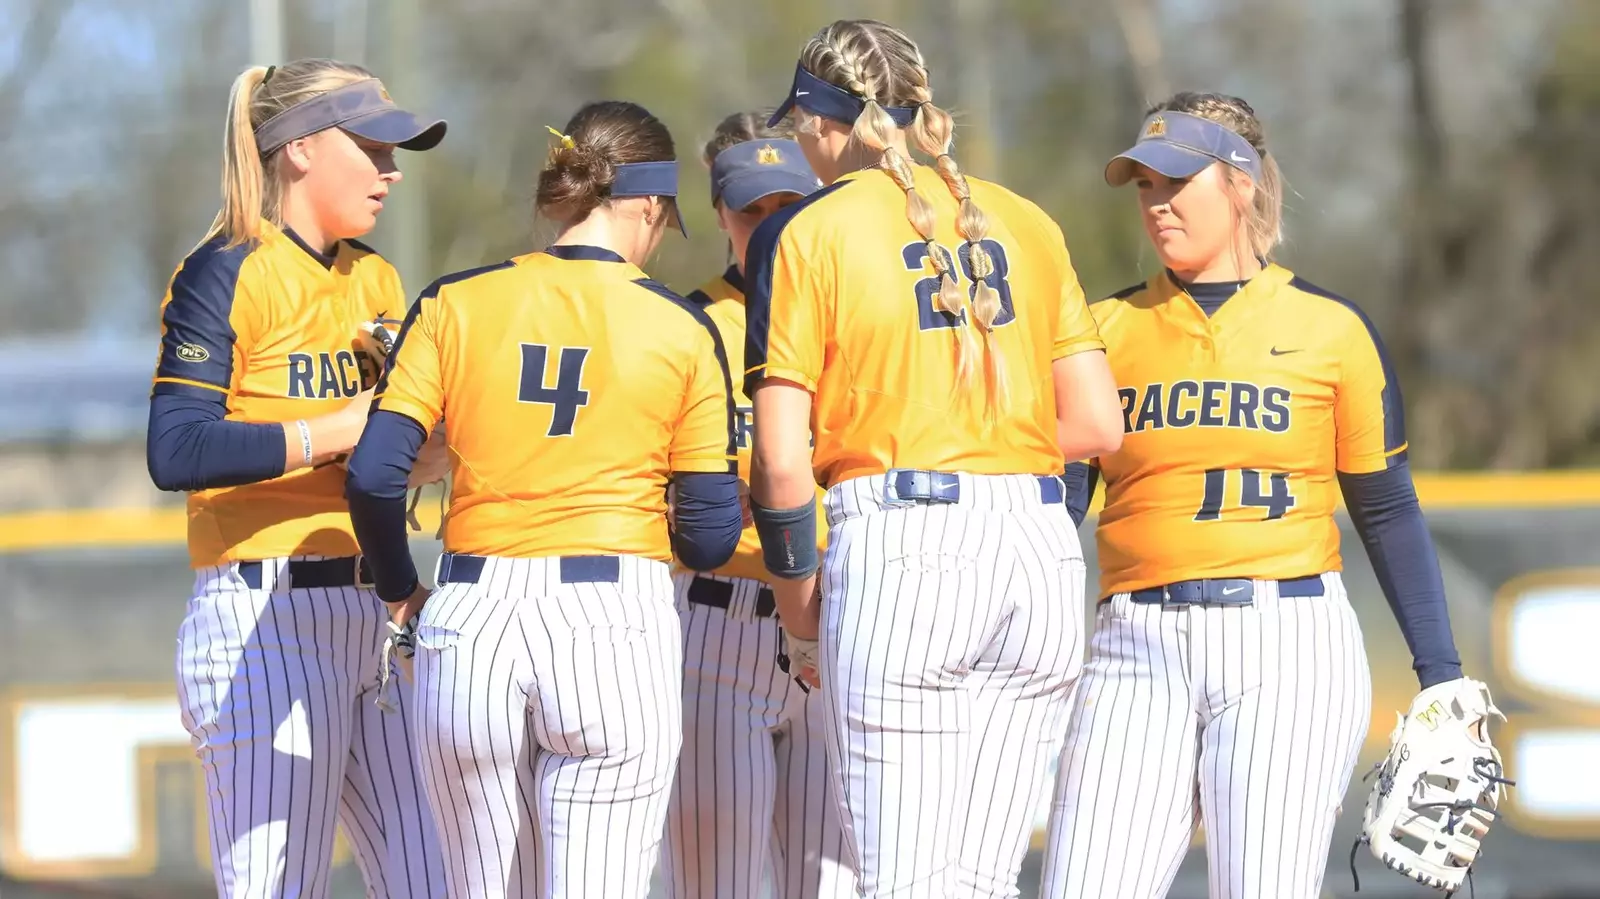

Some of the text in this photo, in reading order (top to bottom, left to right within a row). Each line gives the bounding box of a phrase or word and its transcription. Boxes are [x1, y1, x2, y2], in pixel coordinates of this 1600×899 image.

[902, 237, 1016, 332] 28
[287, 350, 371, 400] RACE
[516, 341, 592, 438] 4
[1192, 467, 1295, 521] 14
